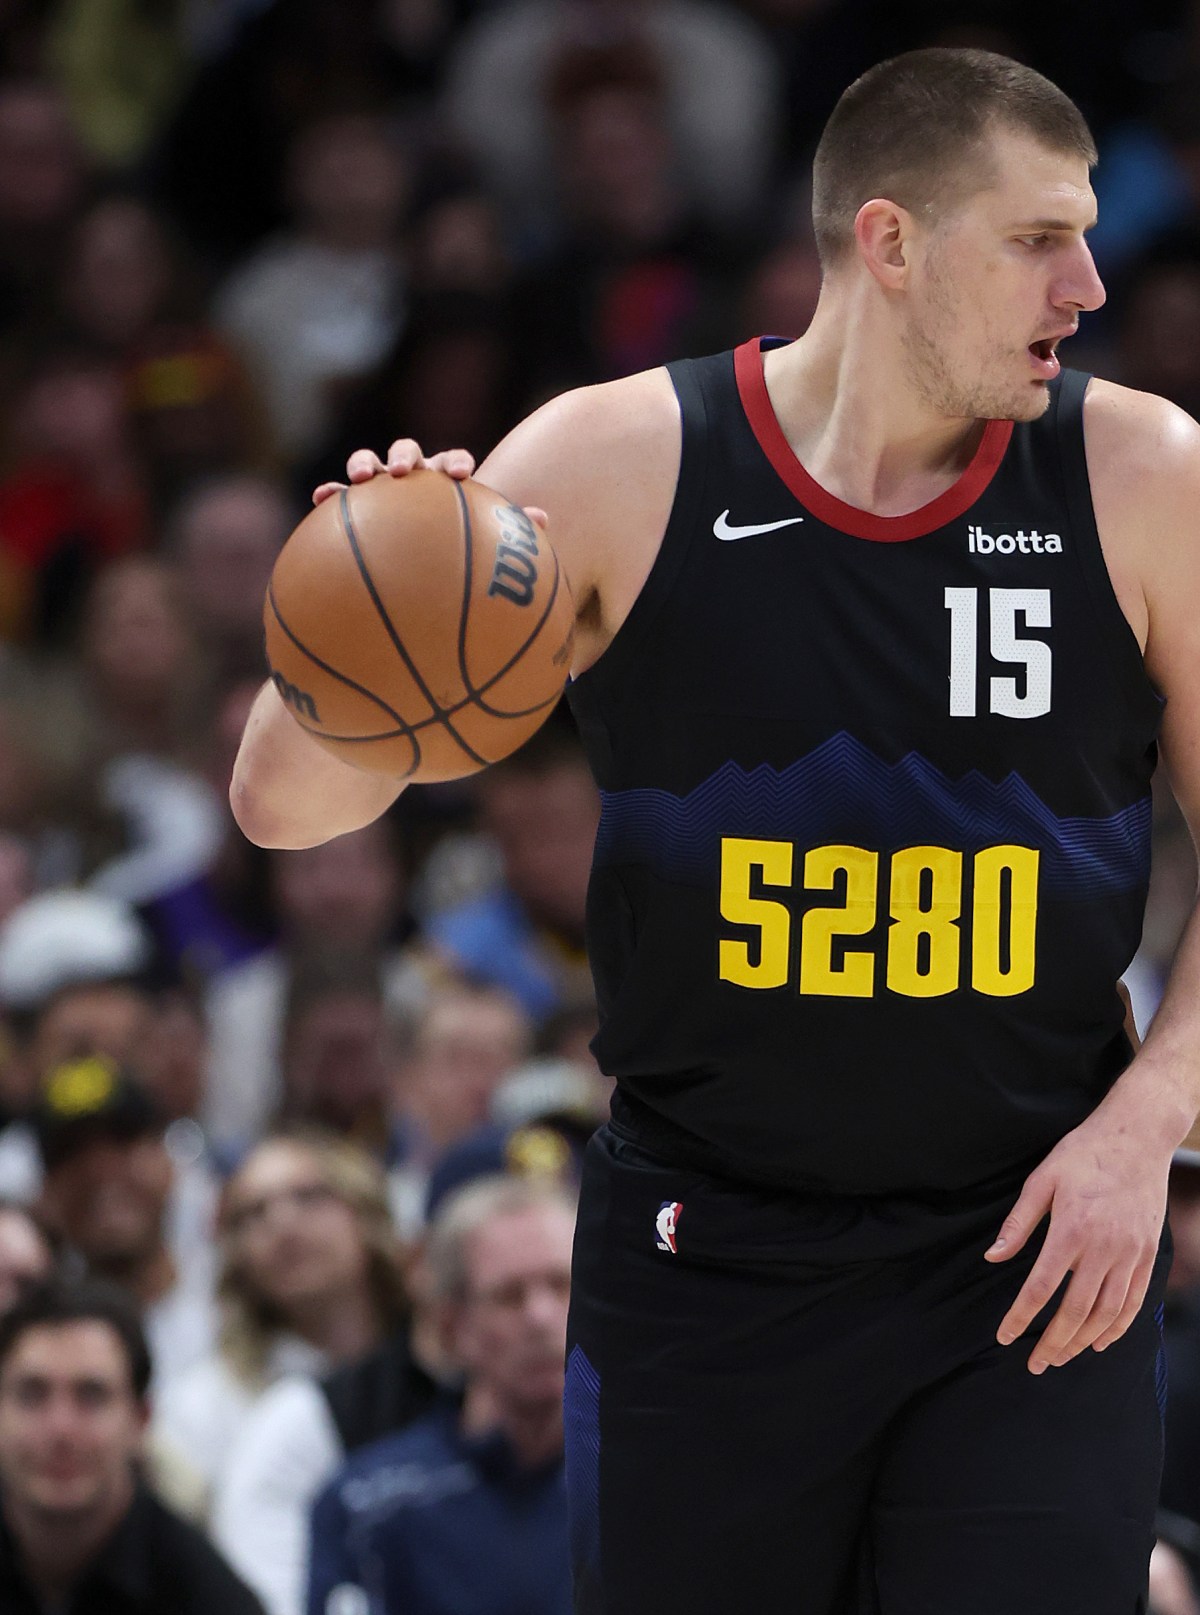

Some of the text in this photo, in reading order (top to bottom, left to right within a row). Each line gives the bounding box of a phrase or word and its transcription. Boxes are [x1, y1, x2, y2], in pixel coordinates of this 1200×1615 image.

[968, 525, 1063, 554] ibotta
[944, 586, 1052, 719] 15
[719, 837, 1040, 998] 5280
